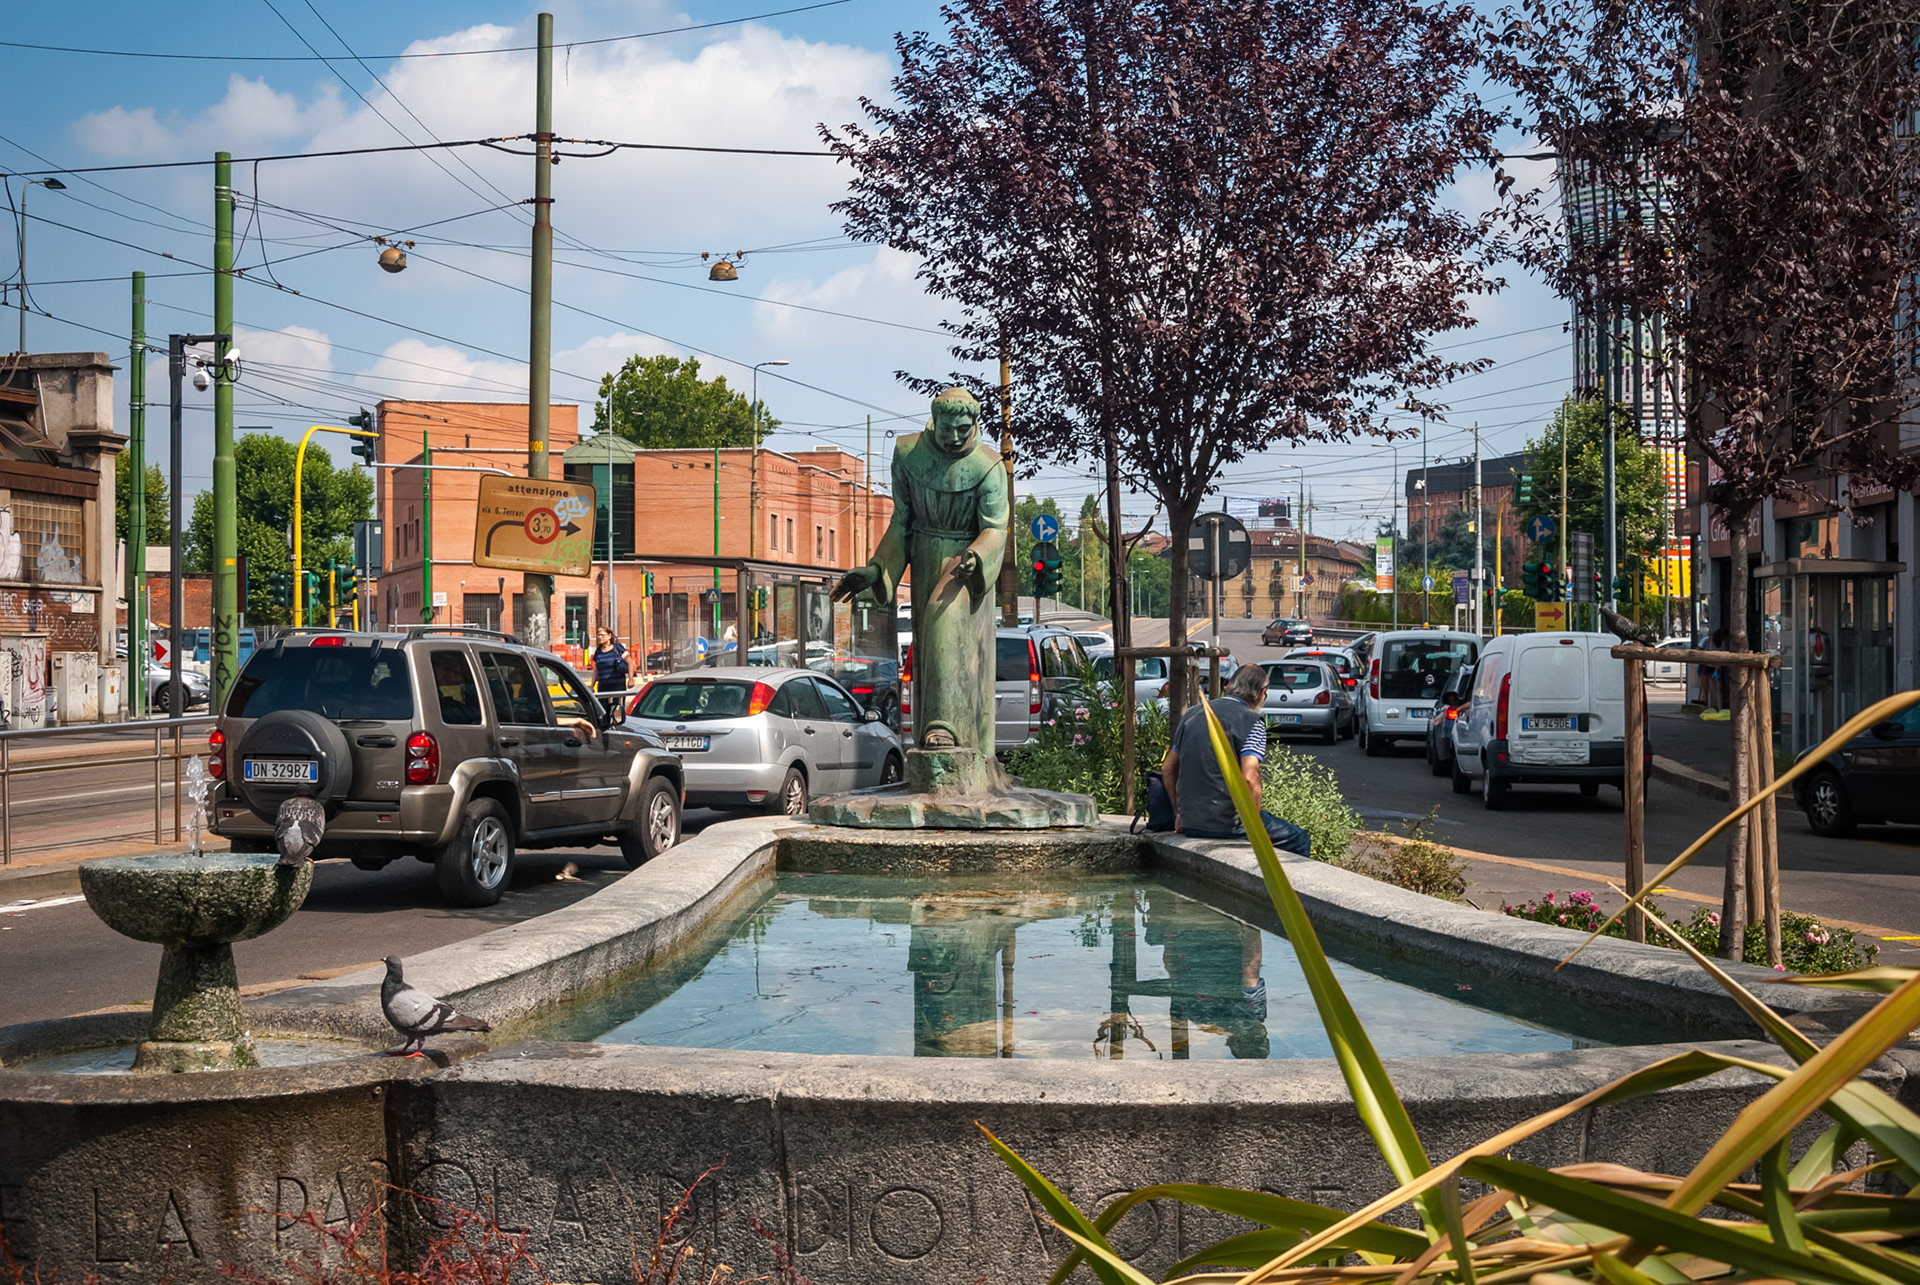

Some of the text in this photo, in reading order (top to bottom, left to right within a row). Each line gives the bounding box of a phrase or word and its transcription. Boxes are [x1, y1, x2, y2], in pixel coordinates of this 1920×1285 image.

[507, 484, 569, 498] attenzione
[482, 506, 491, 514] via
[272, 763, 309, 779] 329BZ
[94, 1186, 202, 1263] LA
[792, 1177, 945, 1261] DIO
